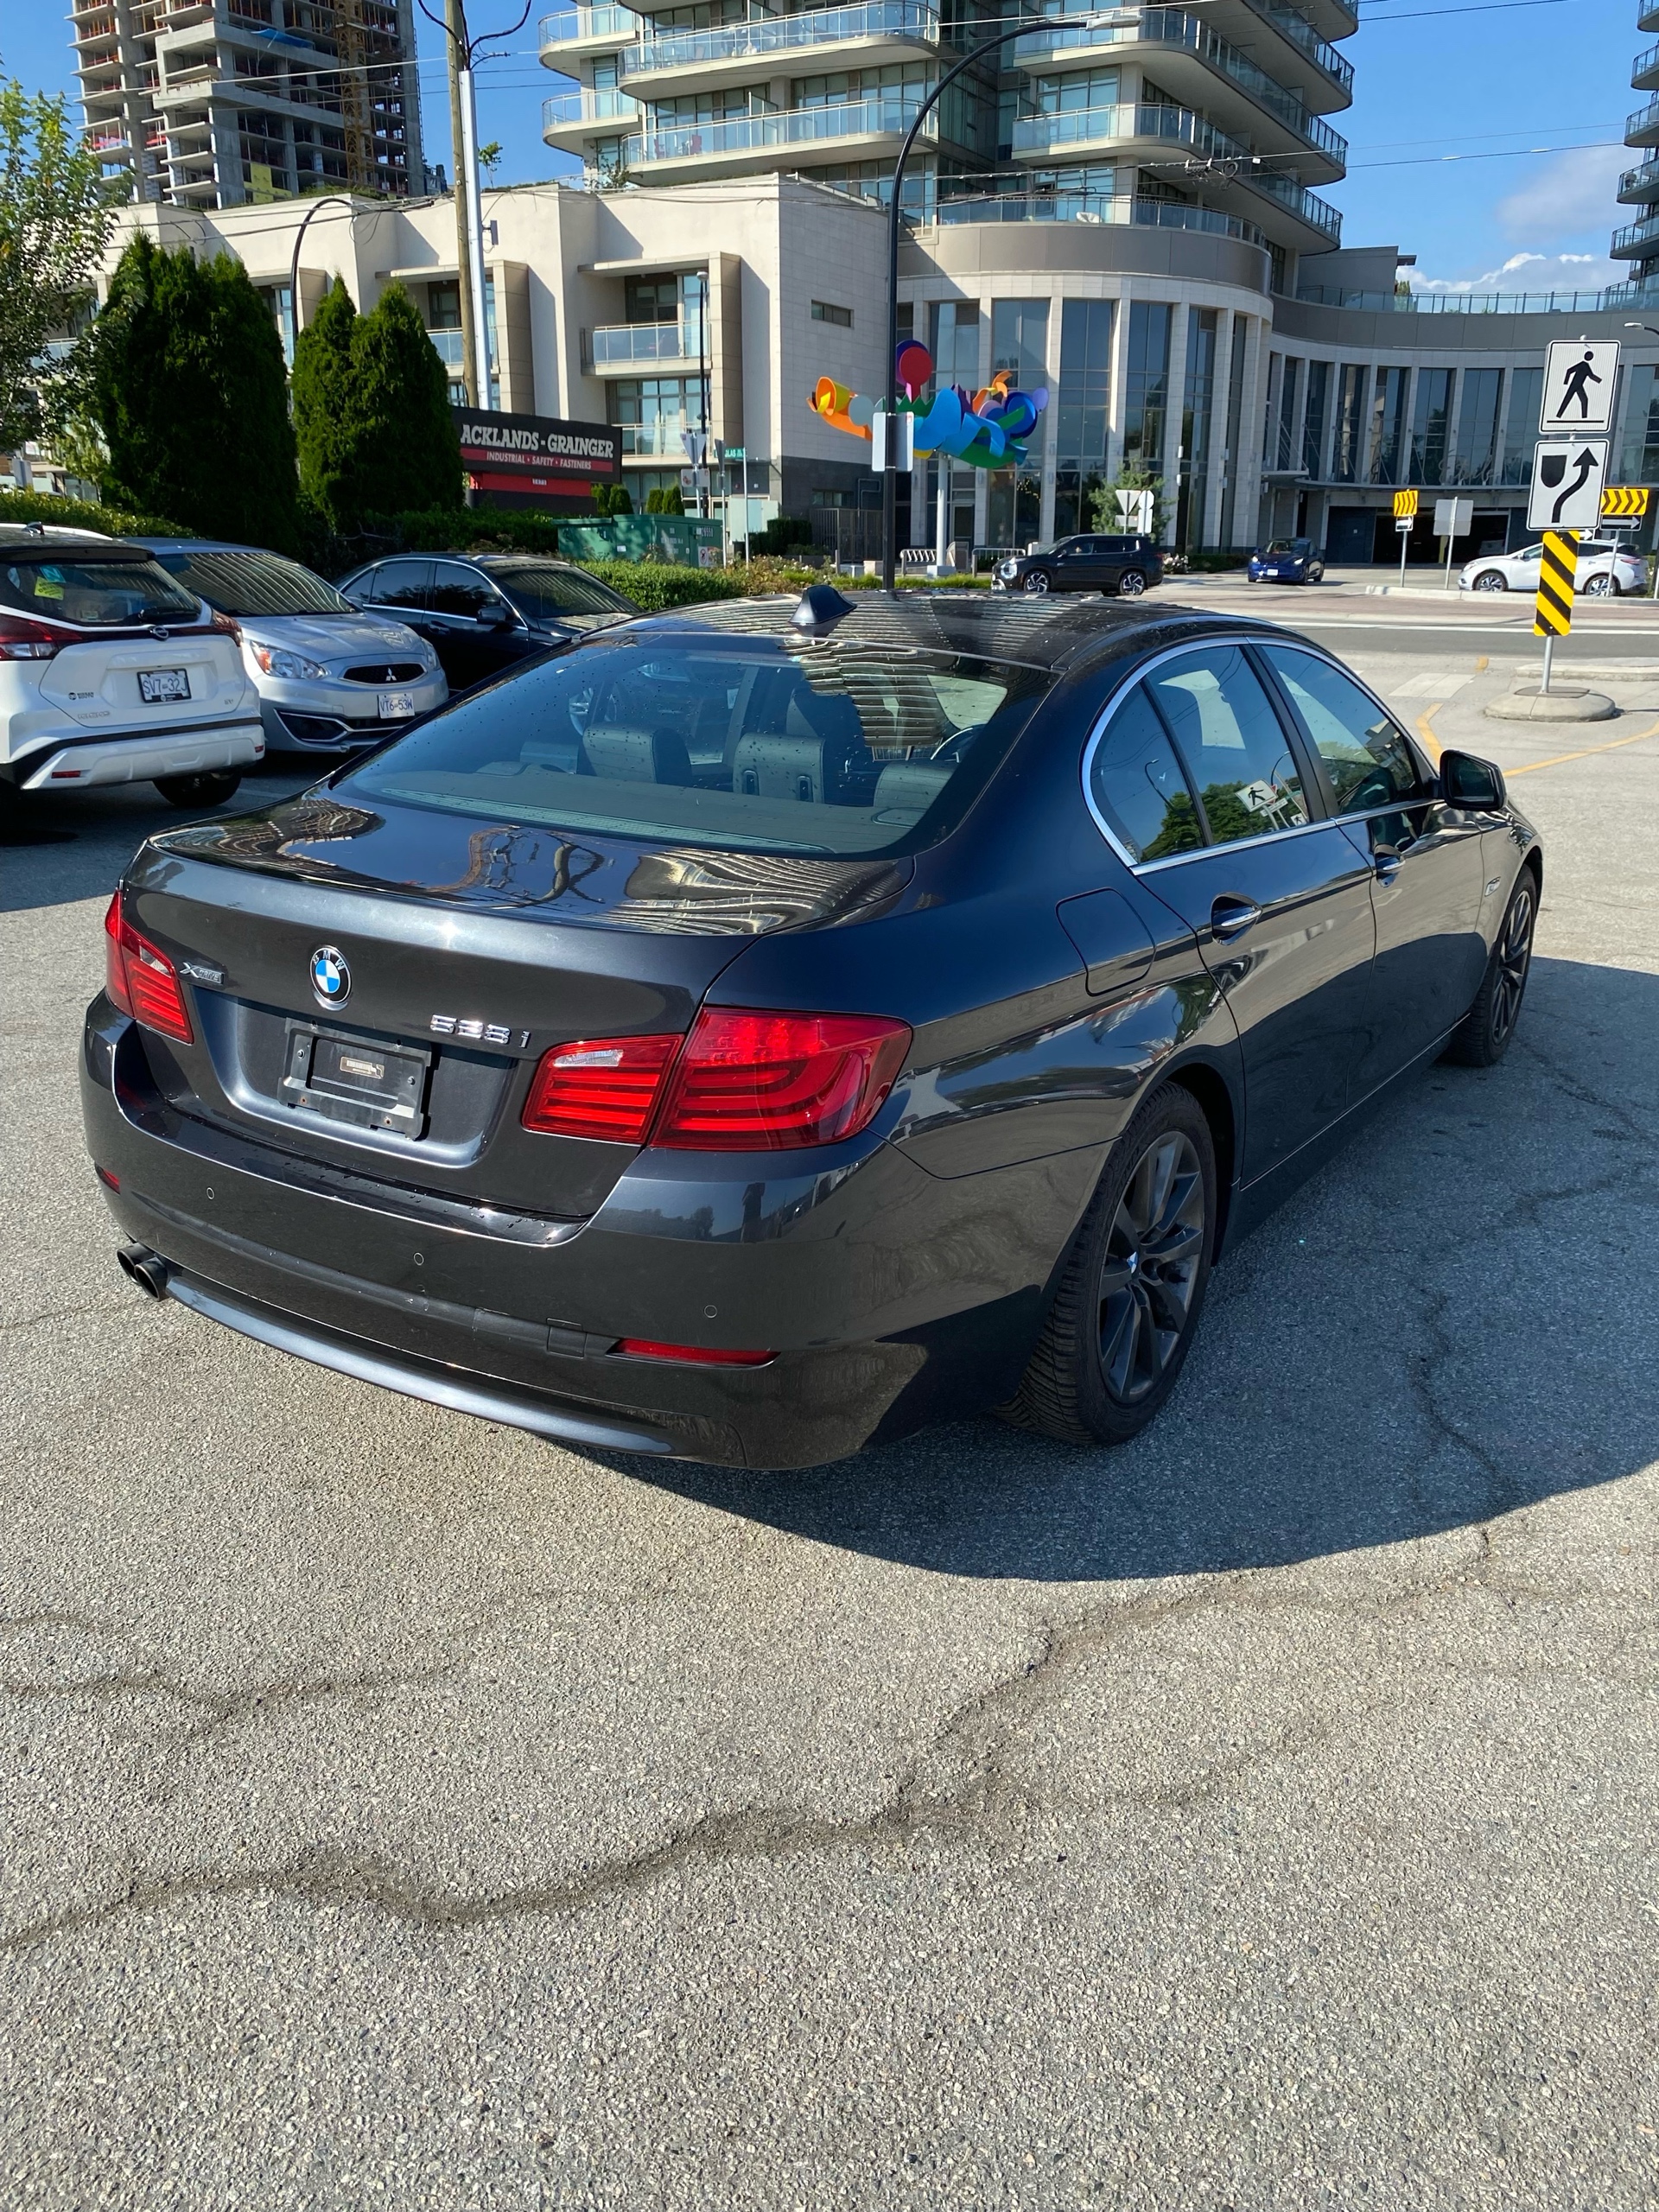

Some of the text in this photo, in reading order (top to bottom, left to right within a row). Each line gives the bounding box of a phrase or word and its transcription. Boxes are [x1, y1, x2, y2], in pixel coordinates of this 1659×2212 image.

[486, 451, 592, 470] INDUSTRIAL SAFETY FASTENERS
